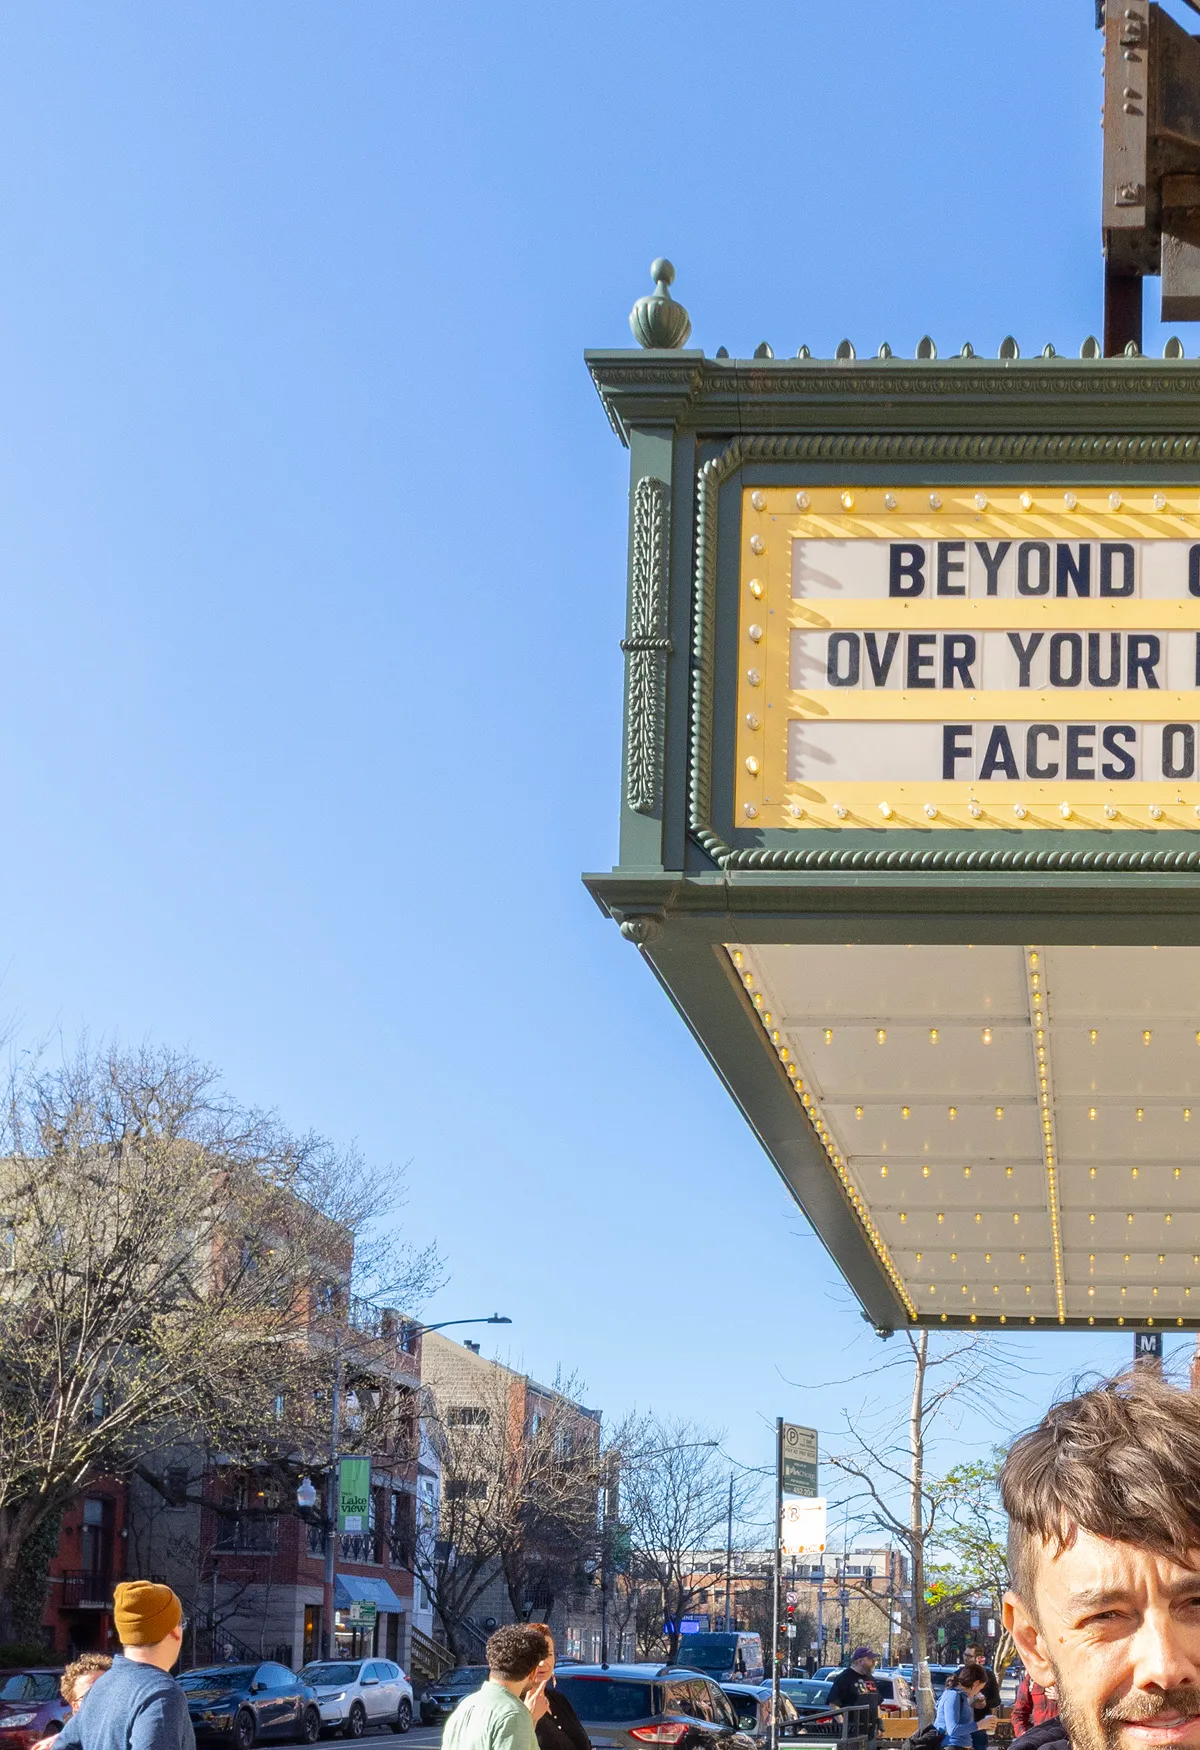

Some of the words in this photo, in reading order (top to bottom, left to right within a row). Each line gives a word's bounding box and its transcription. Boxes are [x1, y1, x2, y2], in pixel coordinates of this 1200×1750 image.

[889, 542, 1135, 597] BEYOND
[828, 632, 976, 689] OVER
[1007, 632, 1161, 689] YOUR
[943, 724, 1136, 780] FACES
[341, 1496, 367, 1505] Lake
[341, 1505, 367, 1513] view
